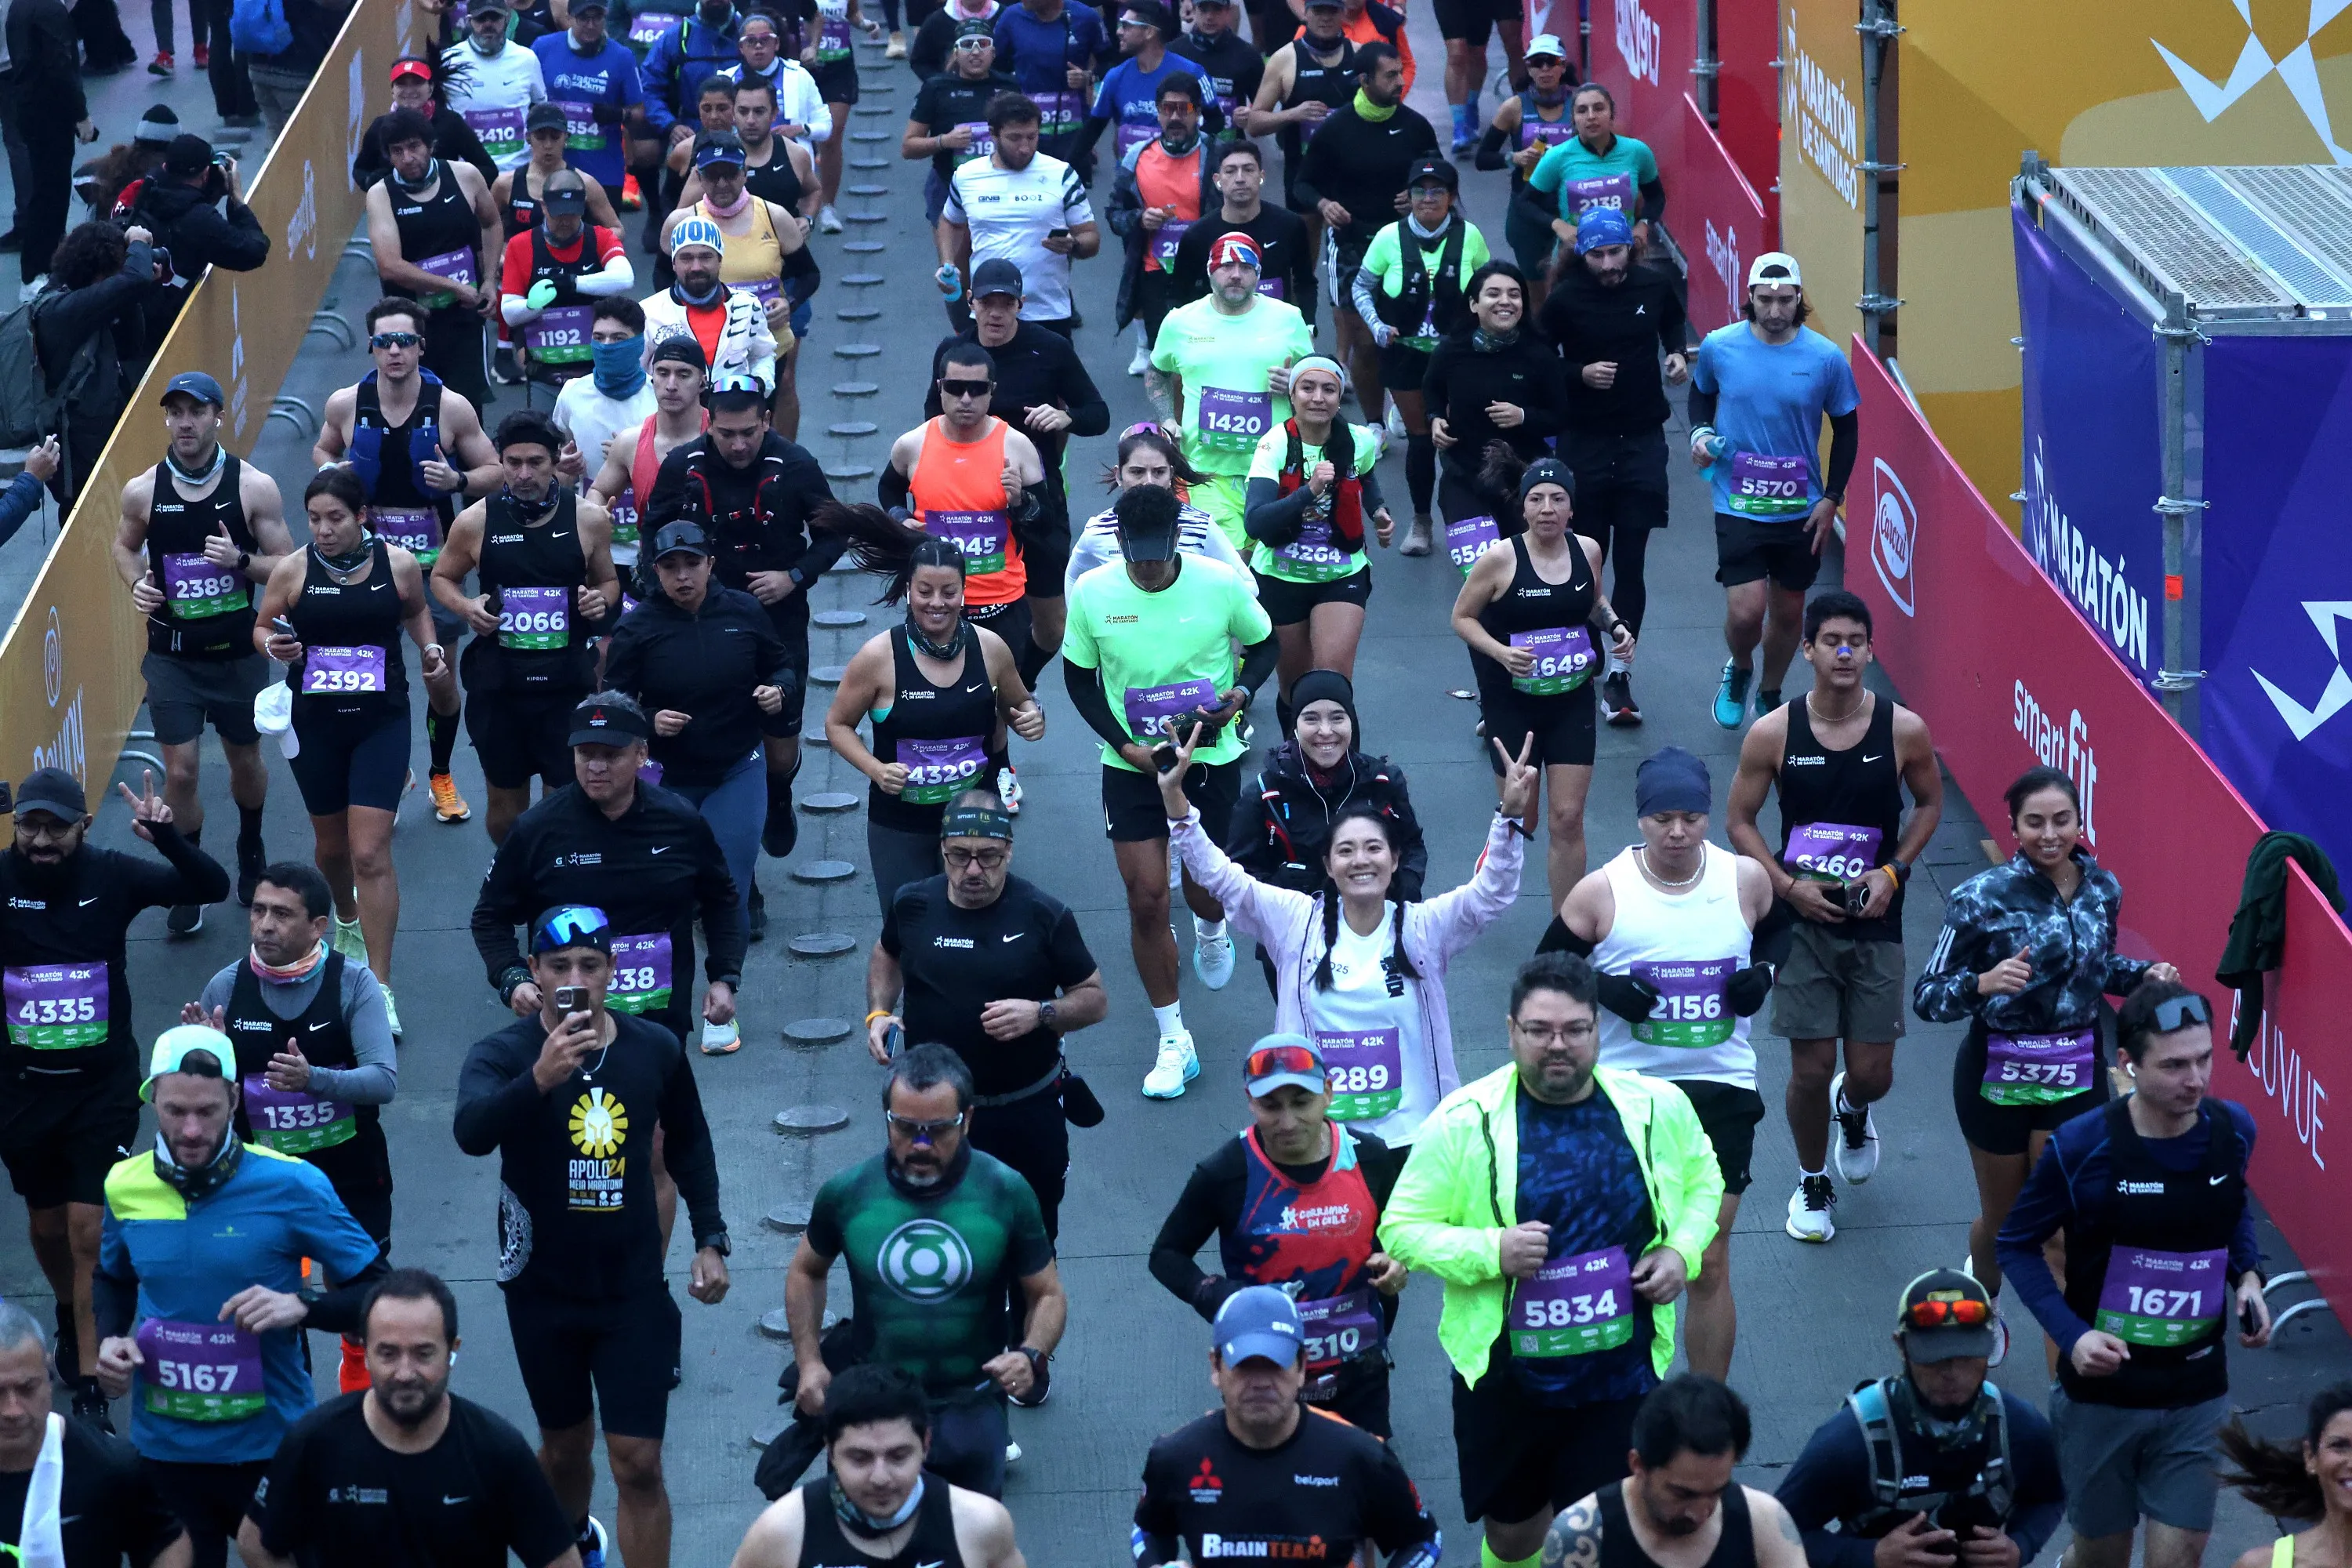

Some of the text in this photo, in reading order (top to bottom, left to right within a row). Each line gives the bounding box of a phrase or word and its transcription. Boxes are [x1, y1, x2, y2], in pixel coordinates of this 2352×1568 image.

[1801, 49, 1855, 161] MARATÓN
[1802, 110, 1857, 210] DE SANTIAGO
[538, 328, 581, 347] 1192
[1208, 412, 1261, 434] 1420
[1741, 477, 1797, 497] 5570
[612, 507, 639, 524] 13
[940, 536, 996, 555] 45
[1284, 542, 1341, 563] 4264
[175, 575, 234, 598] 2389
[2050, 492, 2147, 670] MARATÓN
[499, 612, 564, 631] 2066
[311, 670, 376, 691] 2392
[1146, 691, 1174, 699] MARATÓN
[1180, 687, 1200, 695] 42K
[2014, 678, 2065, 769] smart
[908, 760, 977, 785] 4320
[1813, 828, 1843, 837] MARATÓN
[1849, 832, 1869, 842] 42K
[636, 940, 655, 949] 42K
[69, 970, 91, 979] 42K
[1701, 965, 1722, 976] 42K
[20, 997, 95, 1023] 4335
[1648, 993, 1721, 1020] 2156
[1362, 1036, 1385, 1047] 42K
[1329, 1064, 1388, 1092] 289
[2000, 1062, 2077, 1085] 5375
[264, 1102, 335, 1129] 1335
[569, 1159, 609, 1179] APOLO
[1584, 1257, 1608, 1272] 42K
[2190, 1258, 2210, 1269] 42K
[1525, 1288, 1617, 1328] 5834
[2129, 1287, 2201, 1317] 1671
[209, 1334, 235, 1344] 42K
[1304, 1328, 1360, 1360] 310
[158, 1359, 238, 1392] 5167
[1294, 1474, 1340, 1486] belsport
